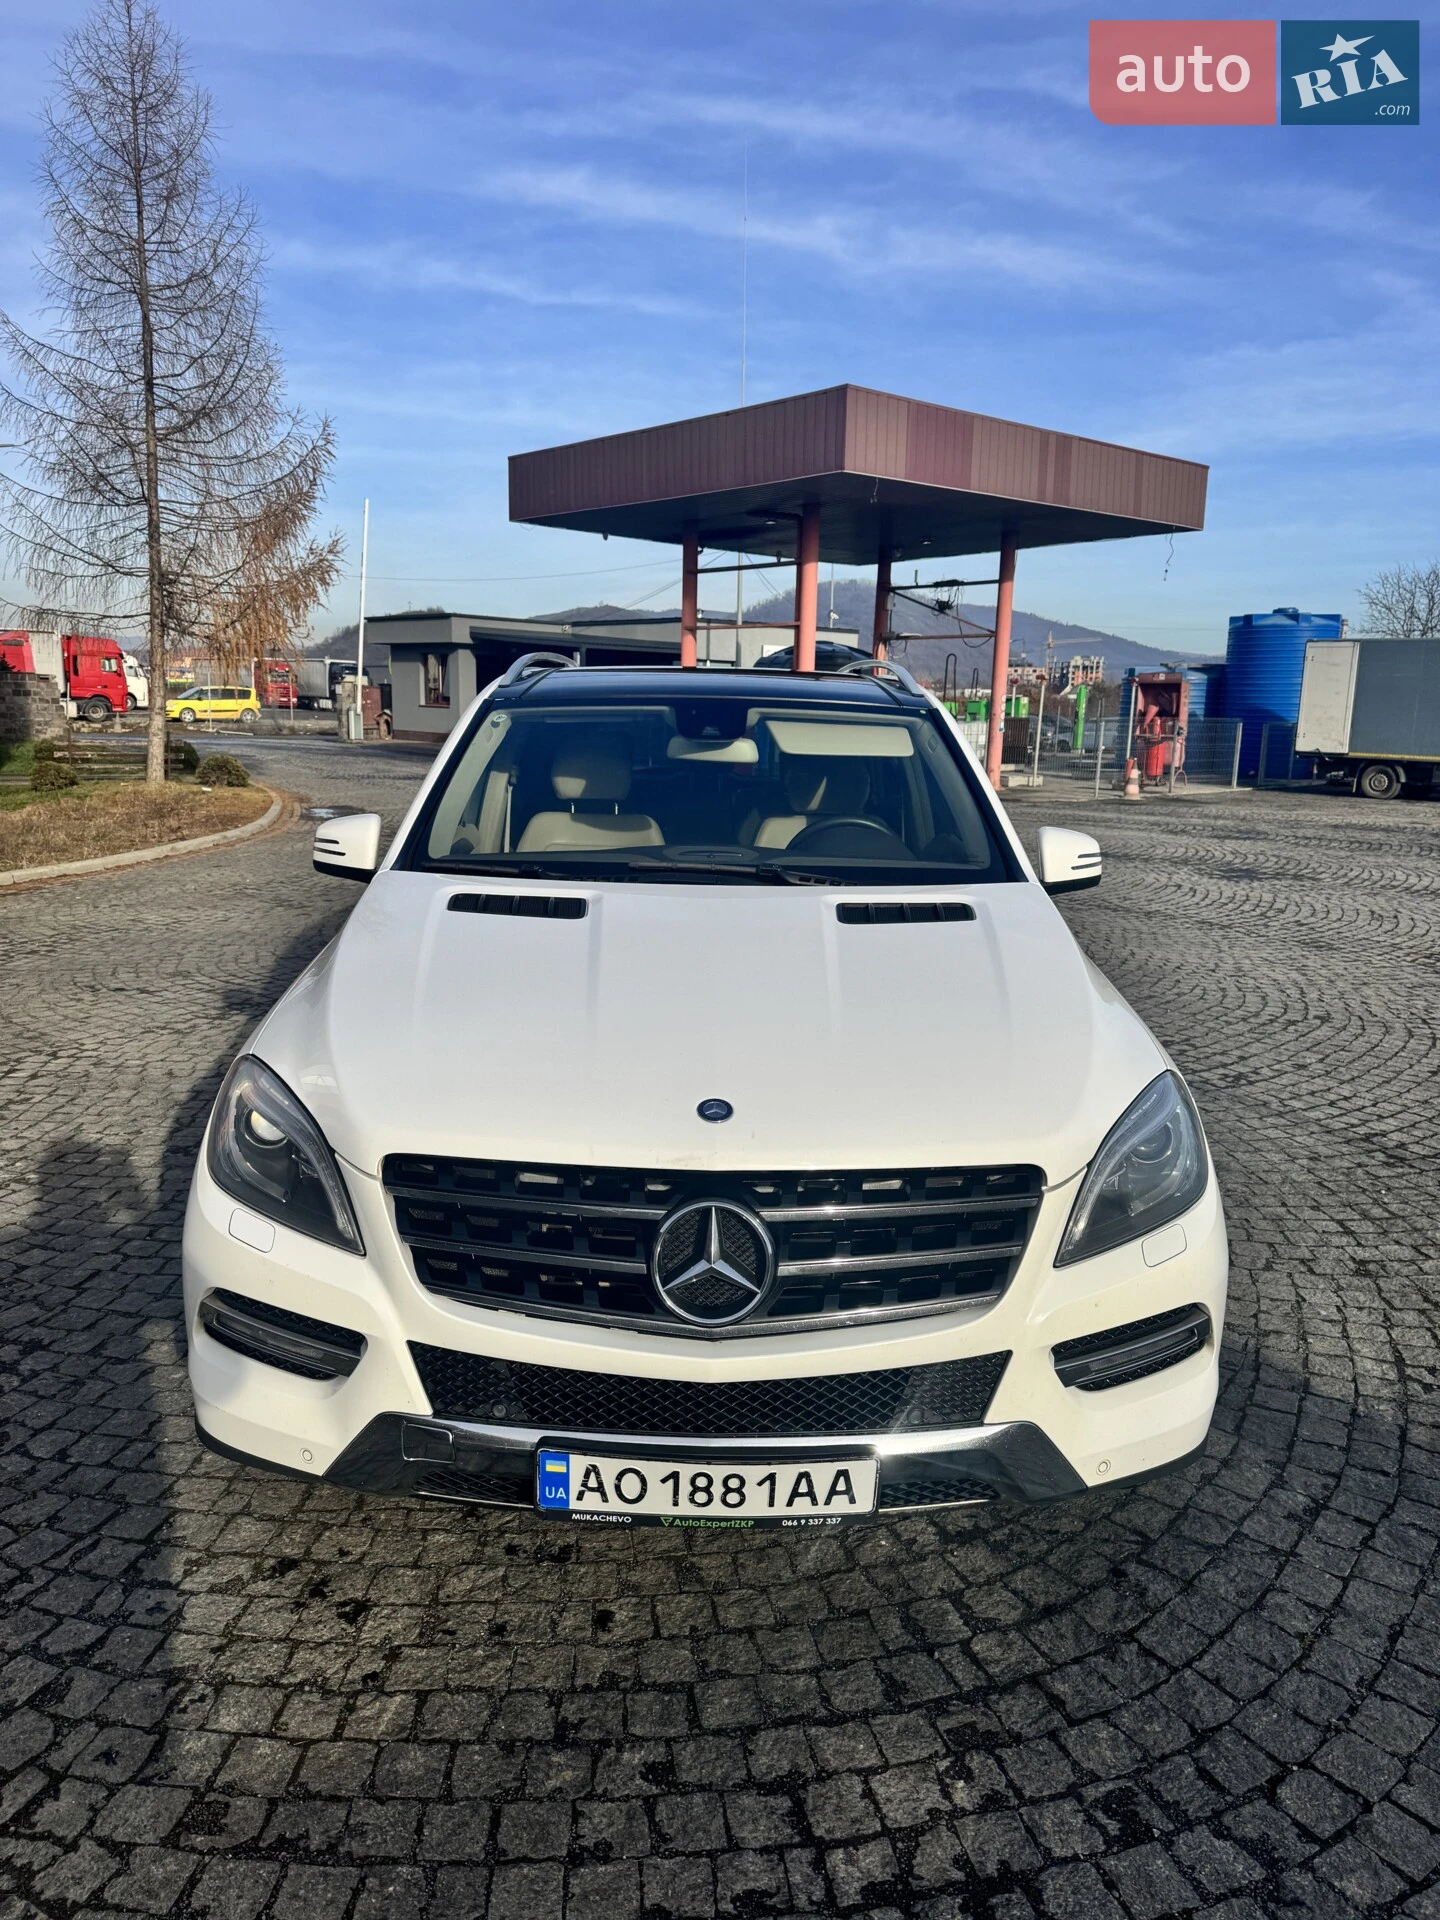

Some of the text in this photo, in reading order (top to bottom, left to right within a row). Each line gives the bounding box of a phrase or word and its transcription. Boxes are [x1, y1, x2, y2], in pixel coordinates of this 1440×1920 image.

[545, 1486, 567, 1500] UA
[571, 1513, 632, 1523] MUKACHEVO
[673, 1518, 755, 1528] AutoExpertZKP
[782, 1519, 799, 1527] 066
[807, 1518, 824, 1526] 337
[826, 1517, 842, 1525] 337
